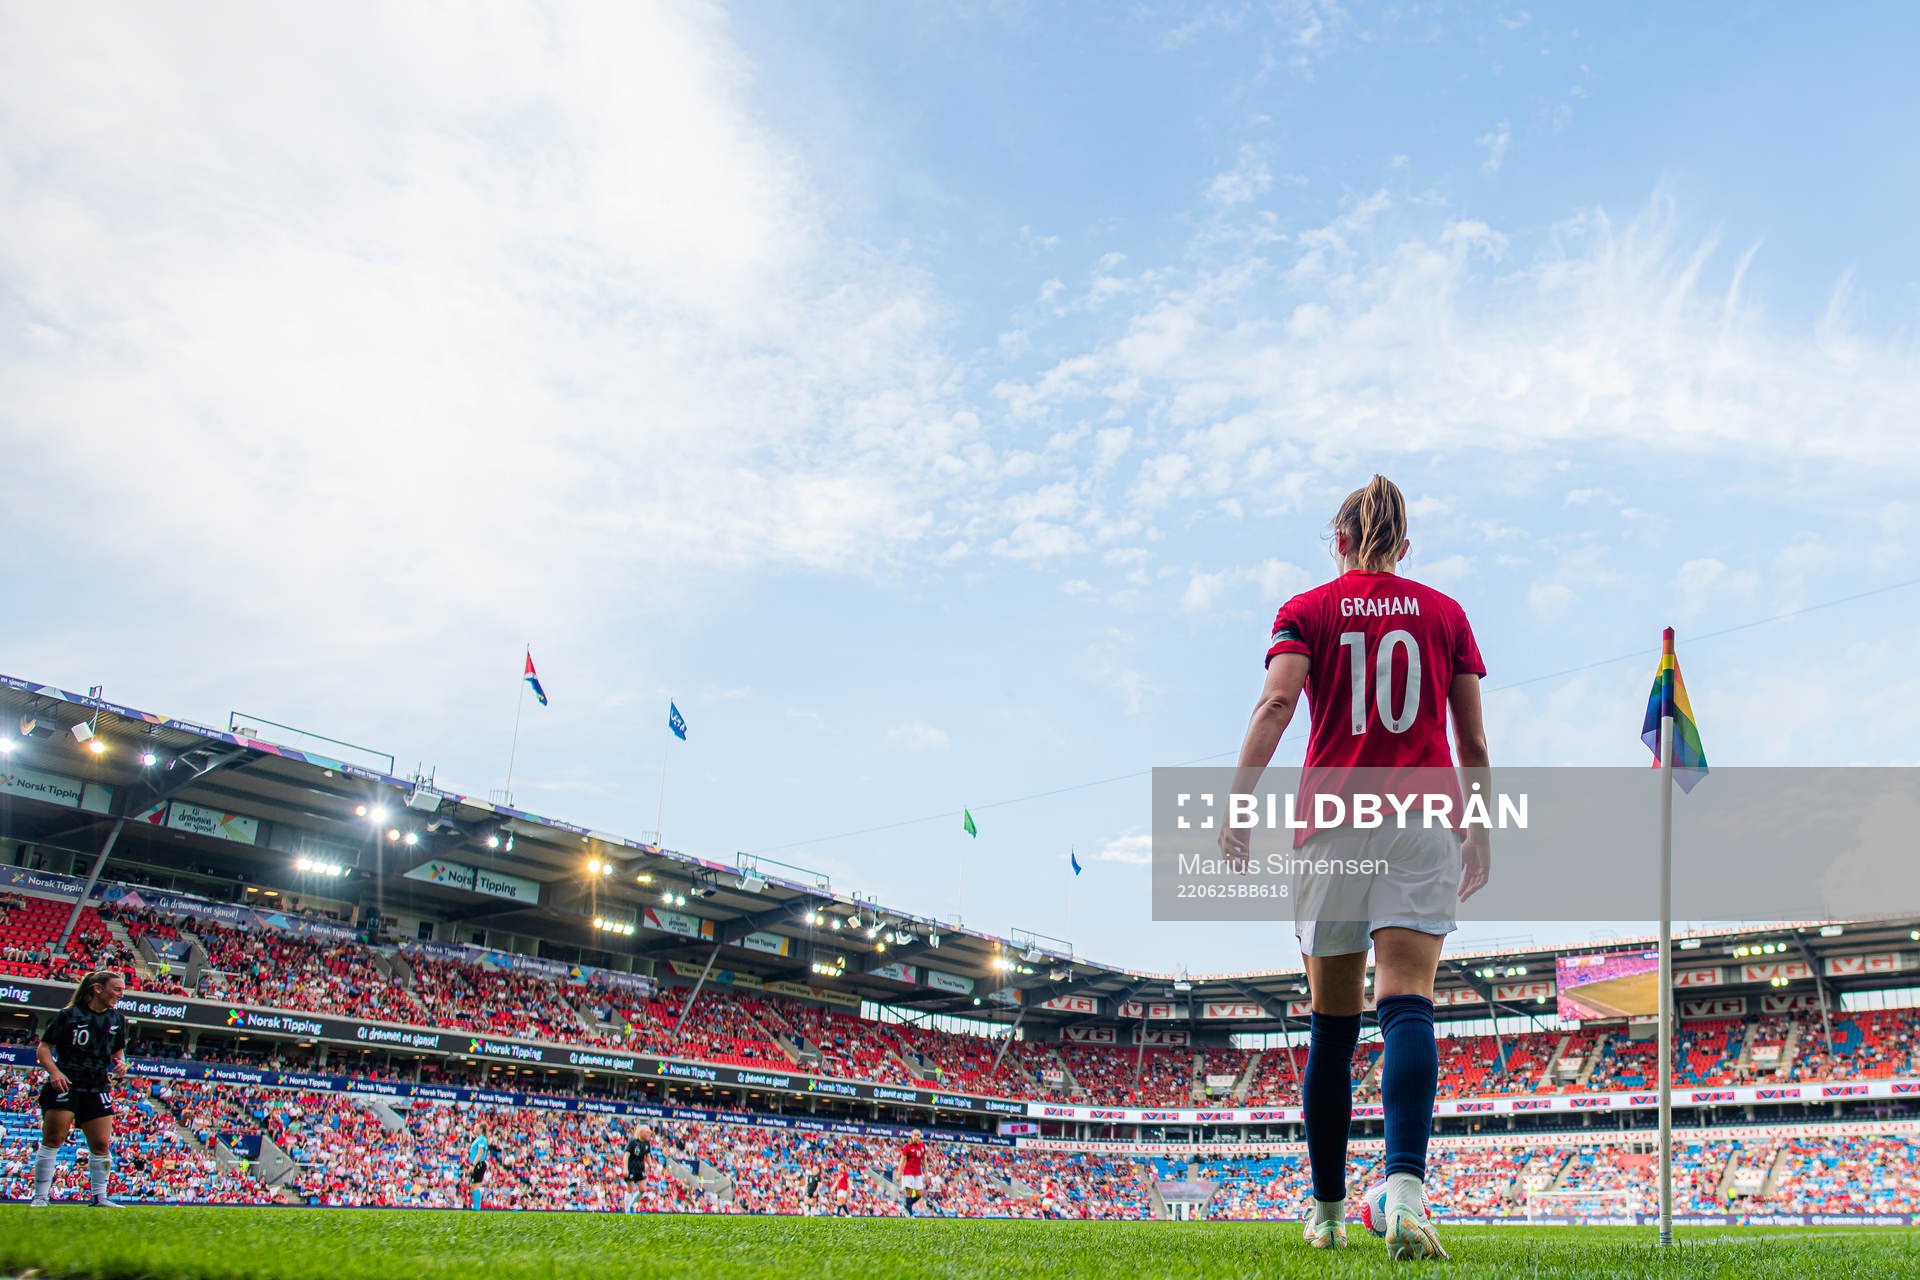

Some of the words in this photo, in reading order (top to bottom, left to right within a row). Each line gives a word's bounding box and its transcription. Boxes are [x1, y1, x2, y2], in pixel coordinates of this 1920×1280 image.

[1340, 597, 1420, 617] GRAHAM
[1340, 629, 1422, 736] 10
[17, 779, 46, 792] Norsk
[48, 785, 80, 800] Tippin
[28, 876, 54, 888] Norsk
[56, 881, 84, 894] Tippin
[448, 871, 473, 885] Nors
[481, 877, 517, 897] Tipping
[213, 908, 239, 920] sjanse!
[1747, 962, 1807, 980] VG
[1833, 954, 1893, 973] VG
[1497, 983, 1550, 999] VG
[138, 1003, 151, 1013] en
[152, 1004, 187, 1019] sjanse!
[1047, 997, 1094, 1012] VG
[1209, 1004, 1260, 1017] VG
[1684, 999, 1741, 1016] VG
[247, 1014, 281, 1029] Norsk
[282, 1017, 322, 1035] Tipping
[72, 1029, 90, 1046] 10
[1063, 1028, 1113, 1042] VG
[1136, 1032, 1188, 1044] VG
[485, 1041, 510, 1055] Norsk
[511, 1045, 542, 1061] Tipping
[137, 1064, 158, 1073] Norsk
[160, 1065, 187, 1077] Tipping
[216, 1071, 236, 1080] Norsk
[238, 1072, 262, 1083] Tipping
[289, 1077, 308, 1086] Norsk
[309, 1079, 332, 1089] Tipping
[1822, 1085, 1868, 1097] VG
[1692, 1091, 1735, 1102] VG
[1756, 1088, 1800, 1100] VG
